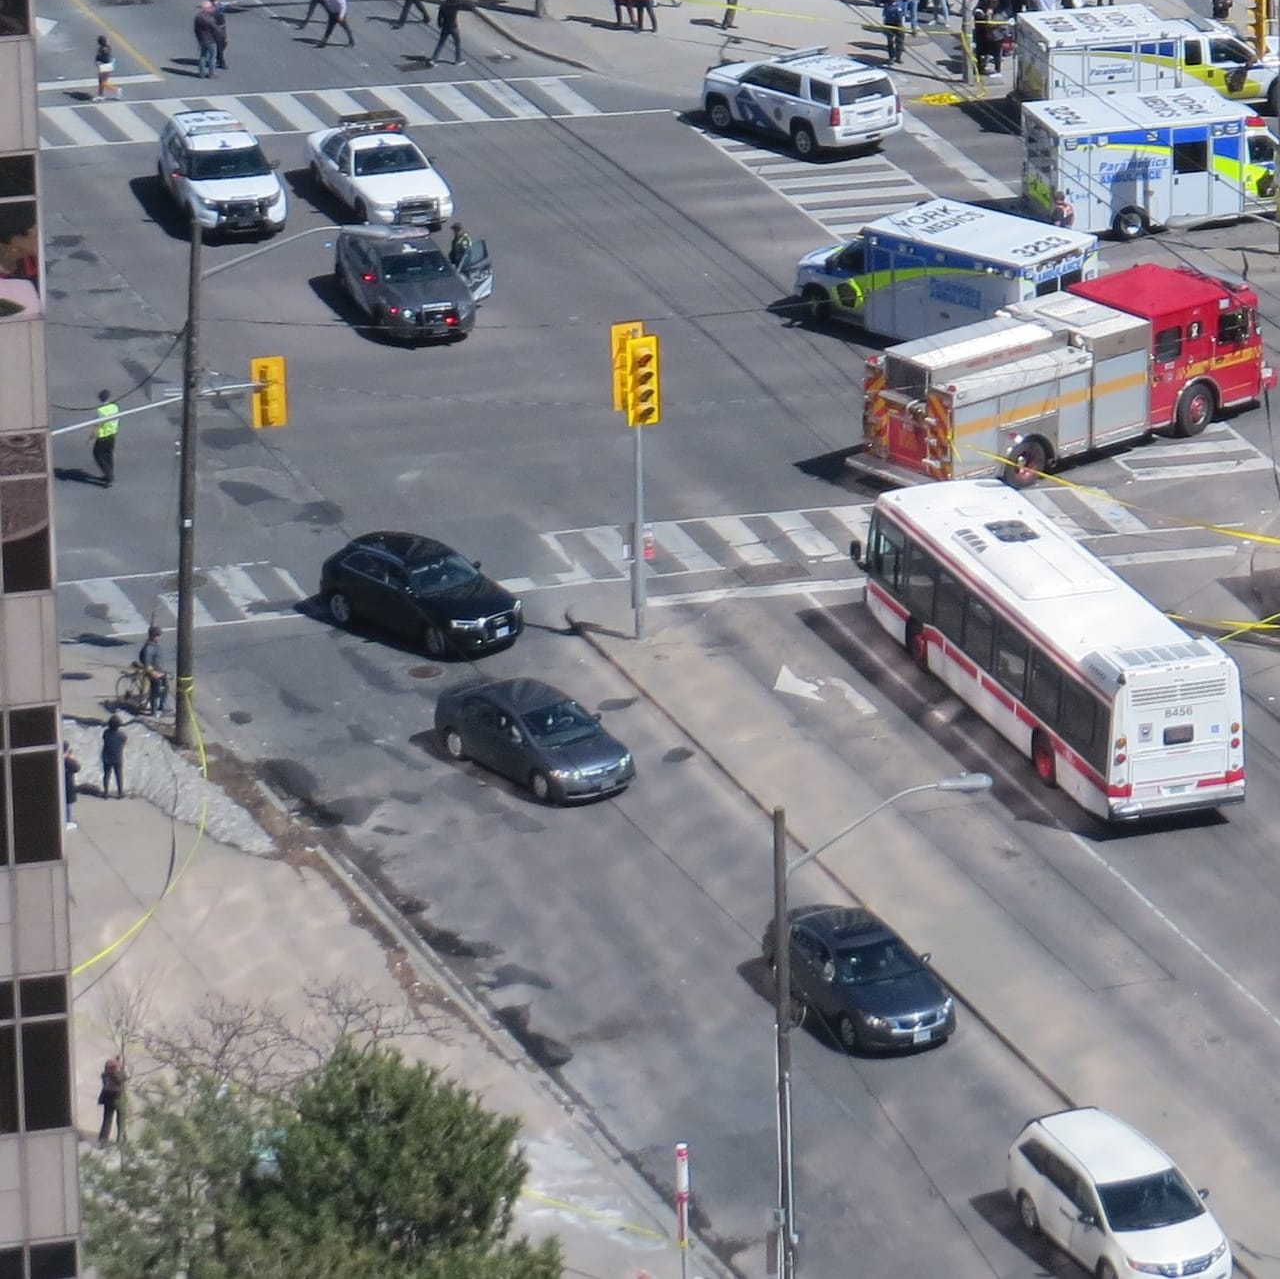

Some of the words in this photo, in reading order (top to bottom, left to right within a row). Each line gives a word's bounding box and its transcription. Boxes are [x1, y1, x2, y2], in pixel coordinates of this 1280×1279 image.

[1137, 94, 1182, 119] MEDICS
[1168, 92, 1214, 116] YORK
[1100, 157, 1169, 172] Paramedics
[1100, 171, 1162, 185] AMBULANCE
[894, 204, 962, 230] YORK
[919, 210, 986, 235] MEDICS
[1011, 236, 1073, 259] 3233
